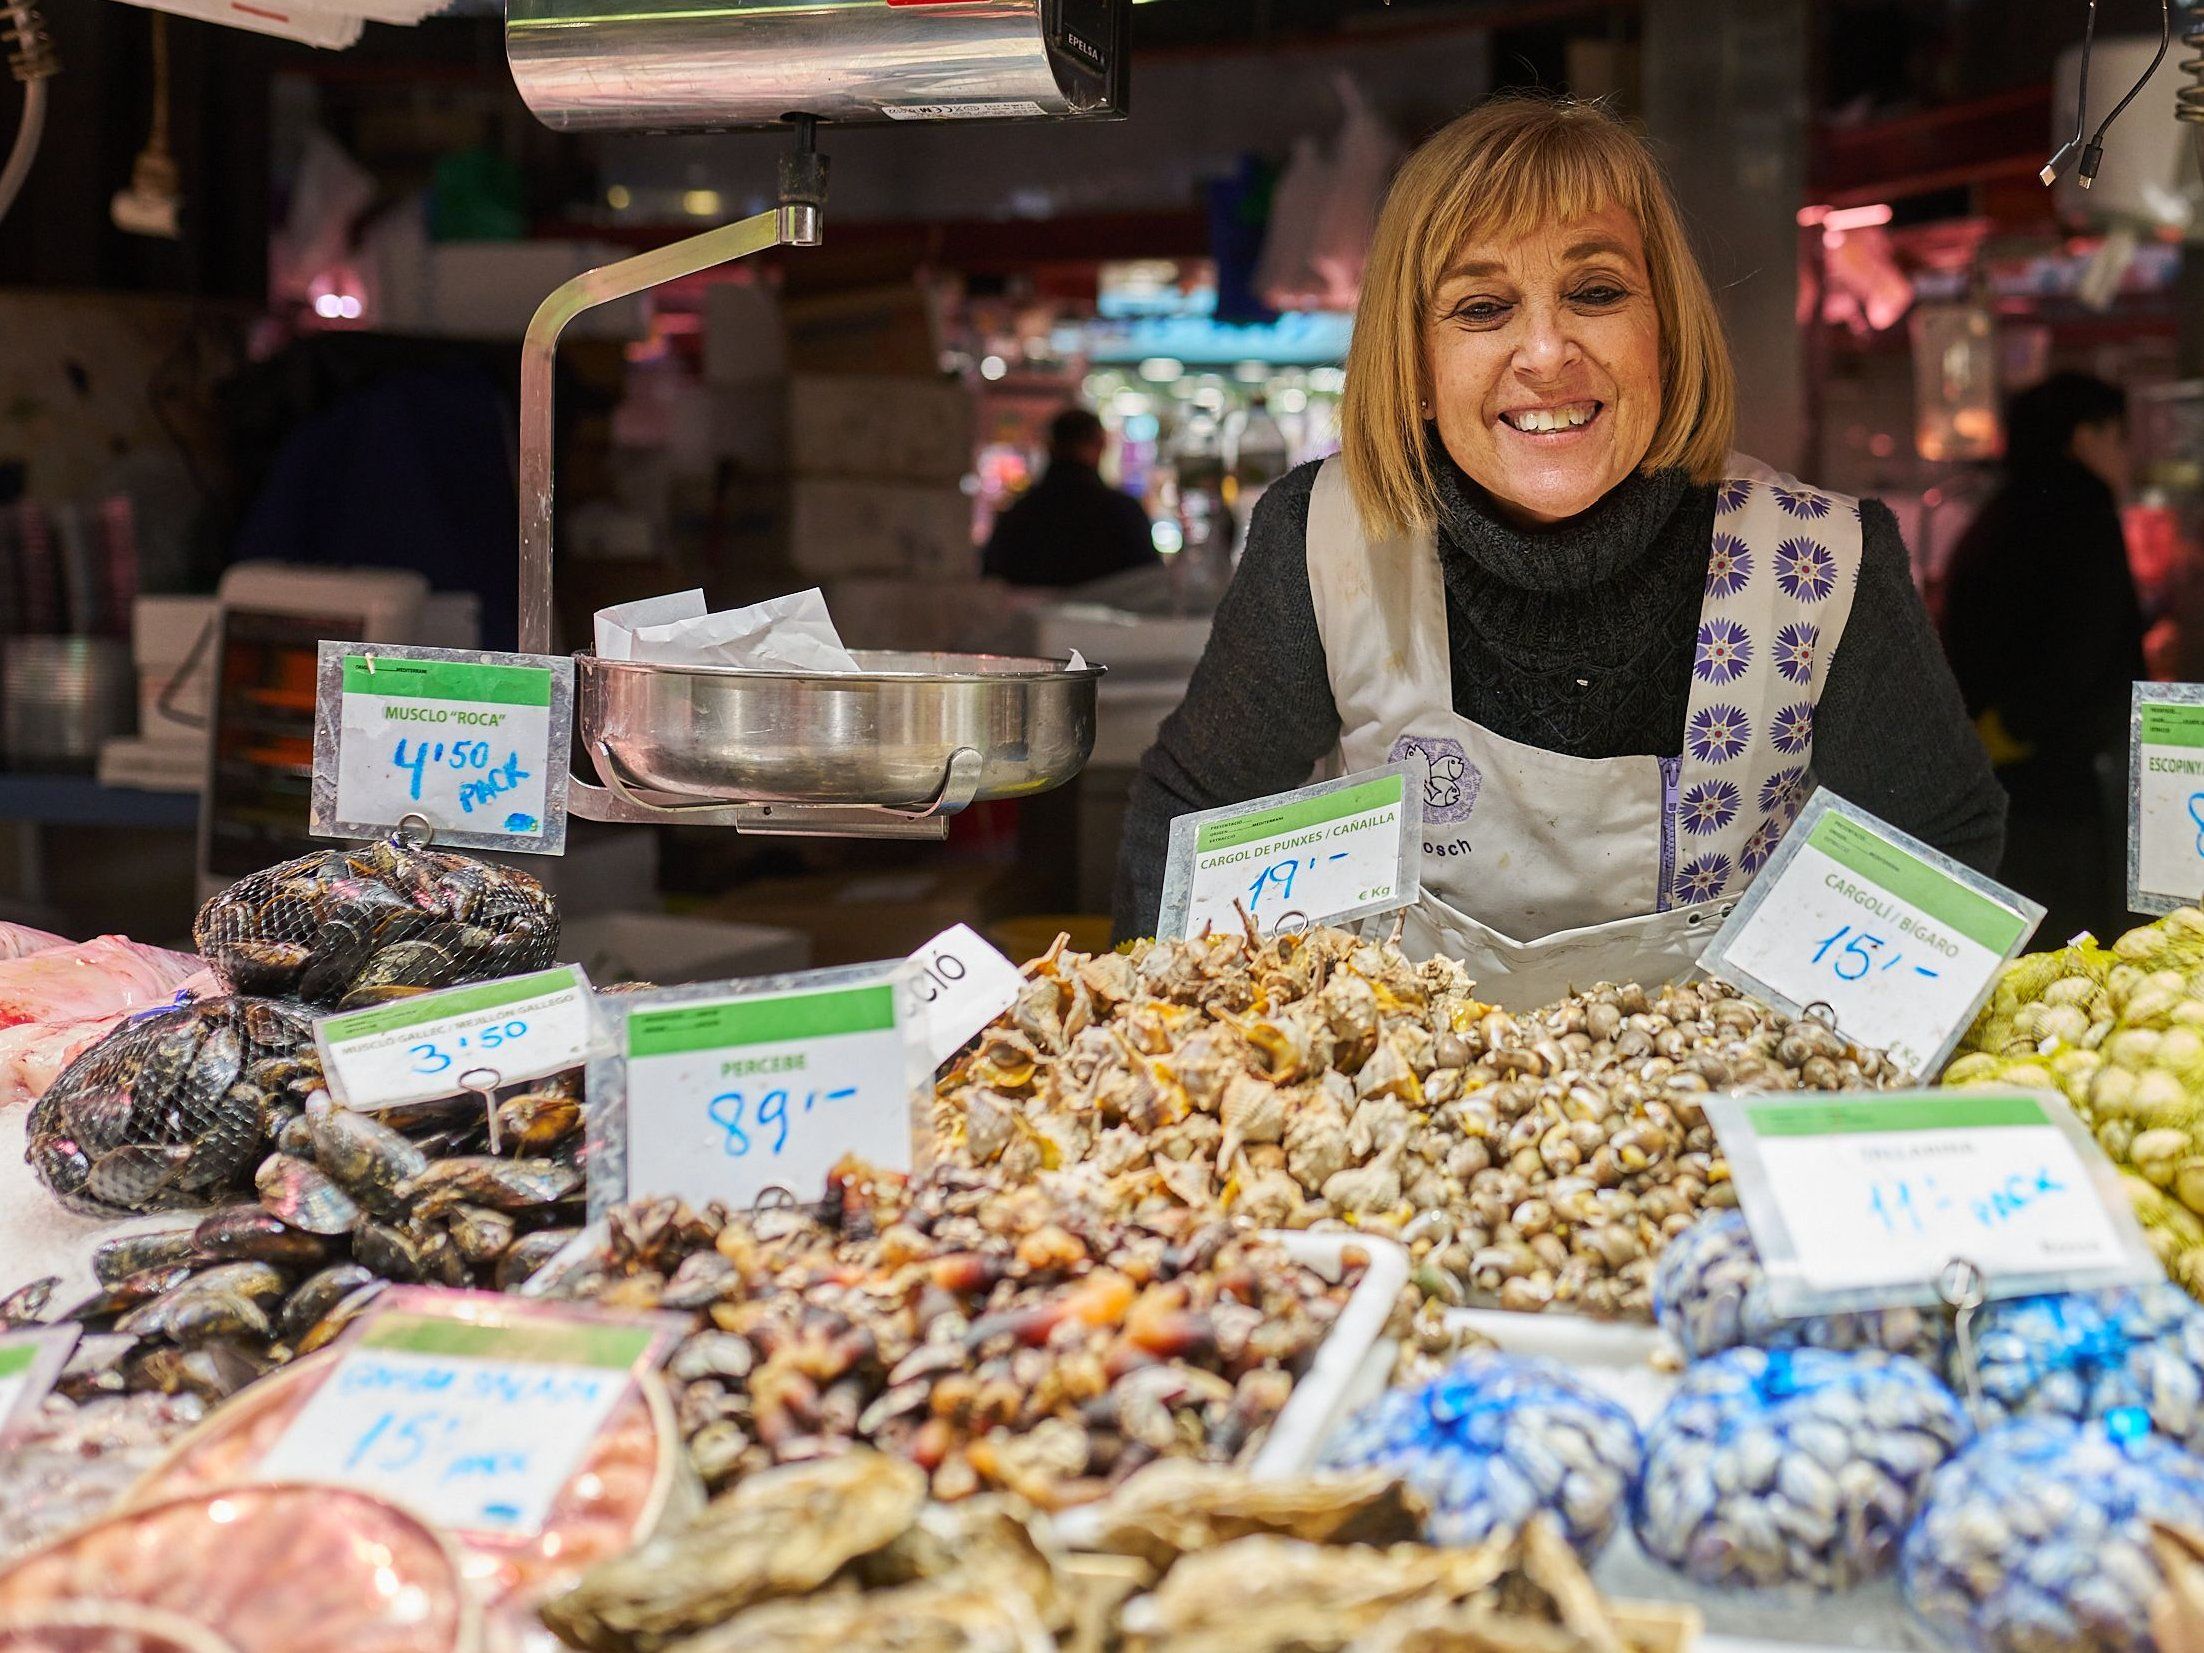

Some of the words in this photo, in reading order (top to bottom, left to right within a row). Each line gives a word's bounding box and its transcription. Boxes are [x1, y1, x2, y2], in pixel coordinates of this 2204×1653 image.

[1068, 33, 1098, 61] EPELSA
[385, 706, 447, 722] MUSCLO
[2150, 756, 2204, 774] ESCOPINY
[460, 751, 530, 813] PACK
[1200, 853, 1251, 870] CARGOL
[1254, 846, 1271, 858] DE
[1273, 832, 1323, 852] PUNXES
[1333, 812, 1395, 837] CAÑAILLA
[1423, 838, 1472, 857] osch
[1371, 886, 1391, 898] Kg
[1825, 873, 1894, 919] CARGOLÍ
[1899, 917, 1960, 959] BÍGARO
[342, 1035, 394, 1054] MUSCLO
[398, 1025, 443, 1043] GALLEC
[517, 994, 574, 1017] GALLEGO
[719, 1054, 808, 1079] PERCEBE
